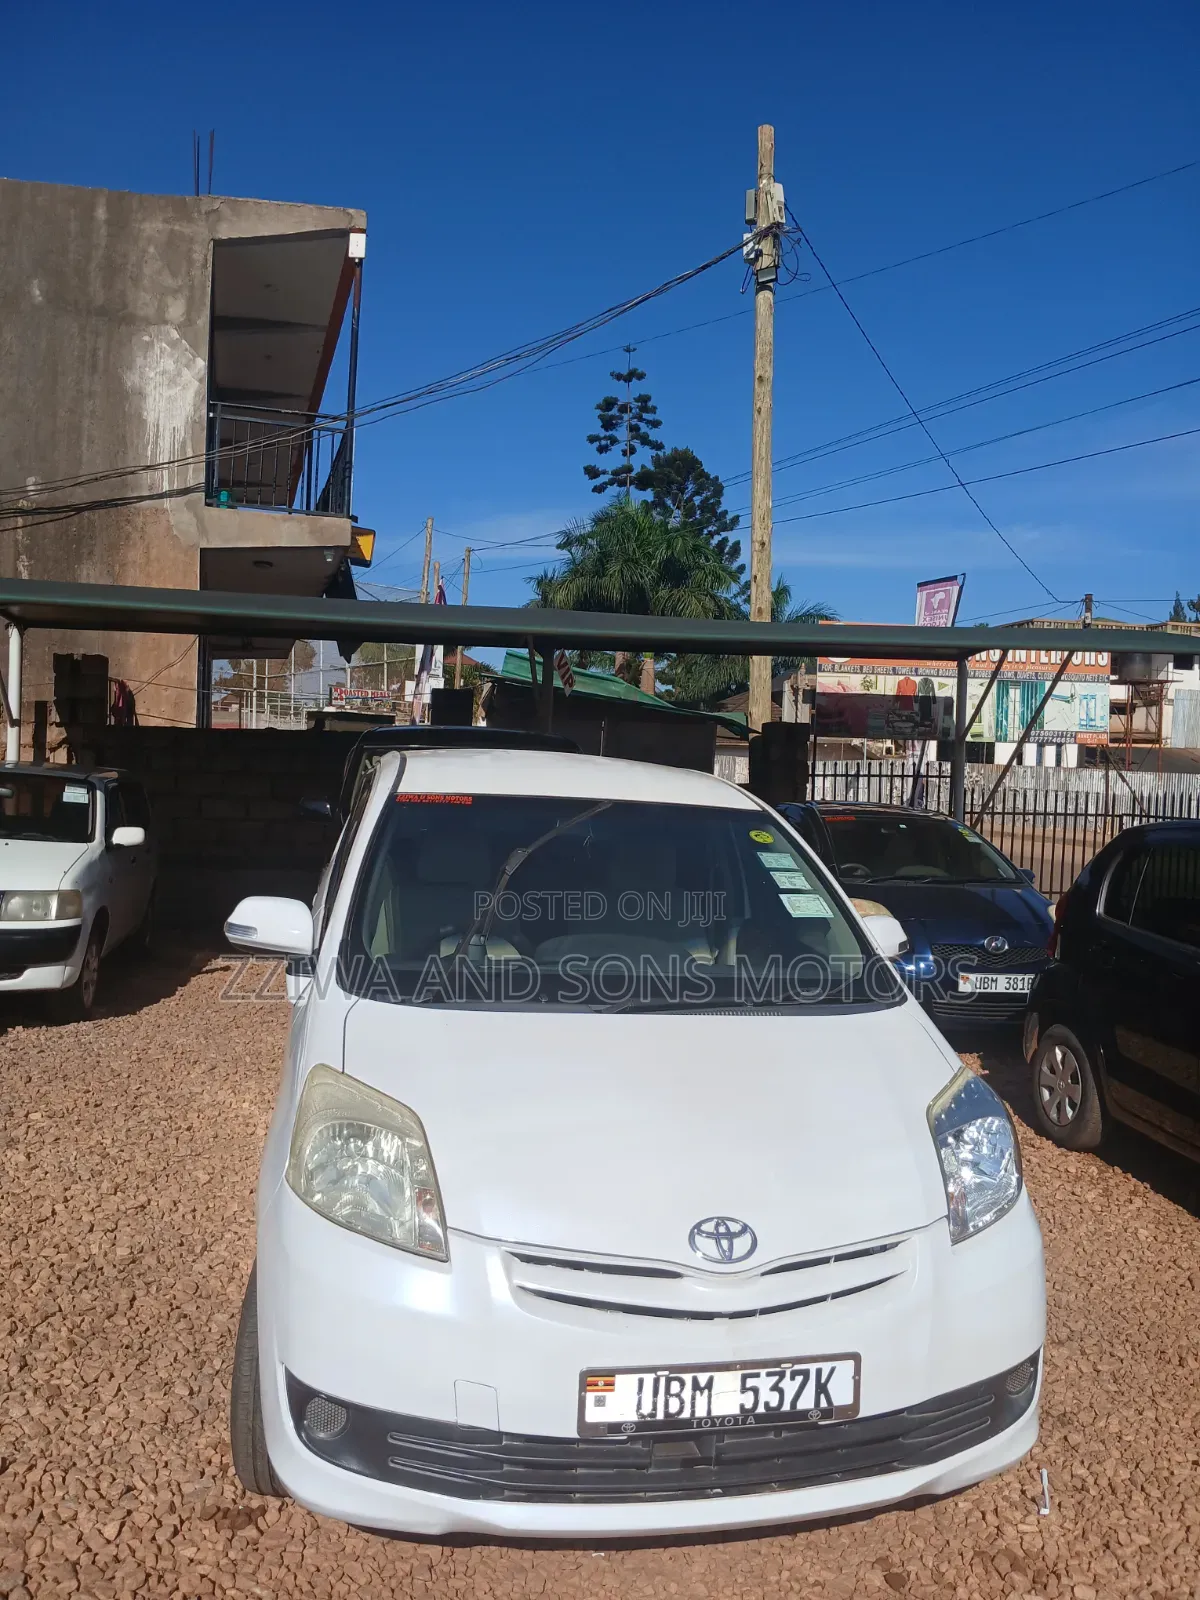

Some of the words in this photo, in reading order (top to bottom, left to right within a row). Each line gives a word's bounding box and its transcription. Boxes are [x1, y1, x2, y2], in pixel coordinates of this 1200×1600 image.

[557, 651, 574, 688] VIP
[636, 1374, 715, 1421] UBM
[739, 1365, 838, 1415] 537K
[690, 1415, 756, 1429] TOYOTA
